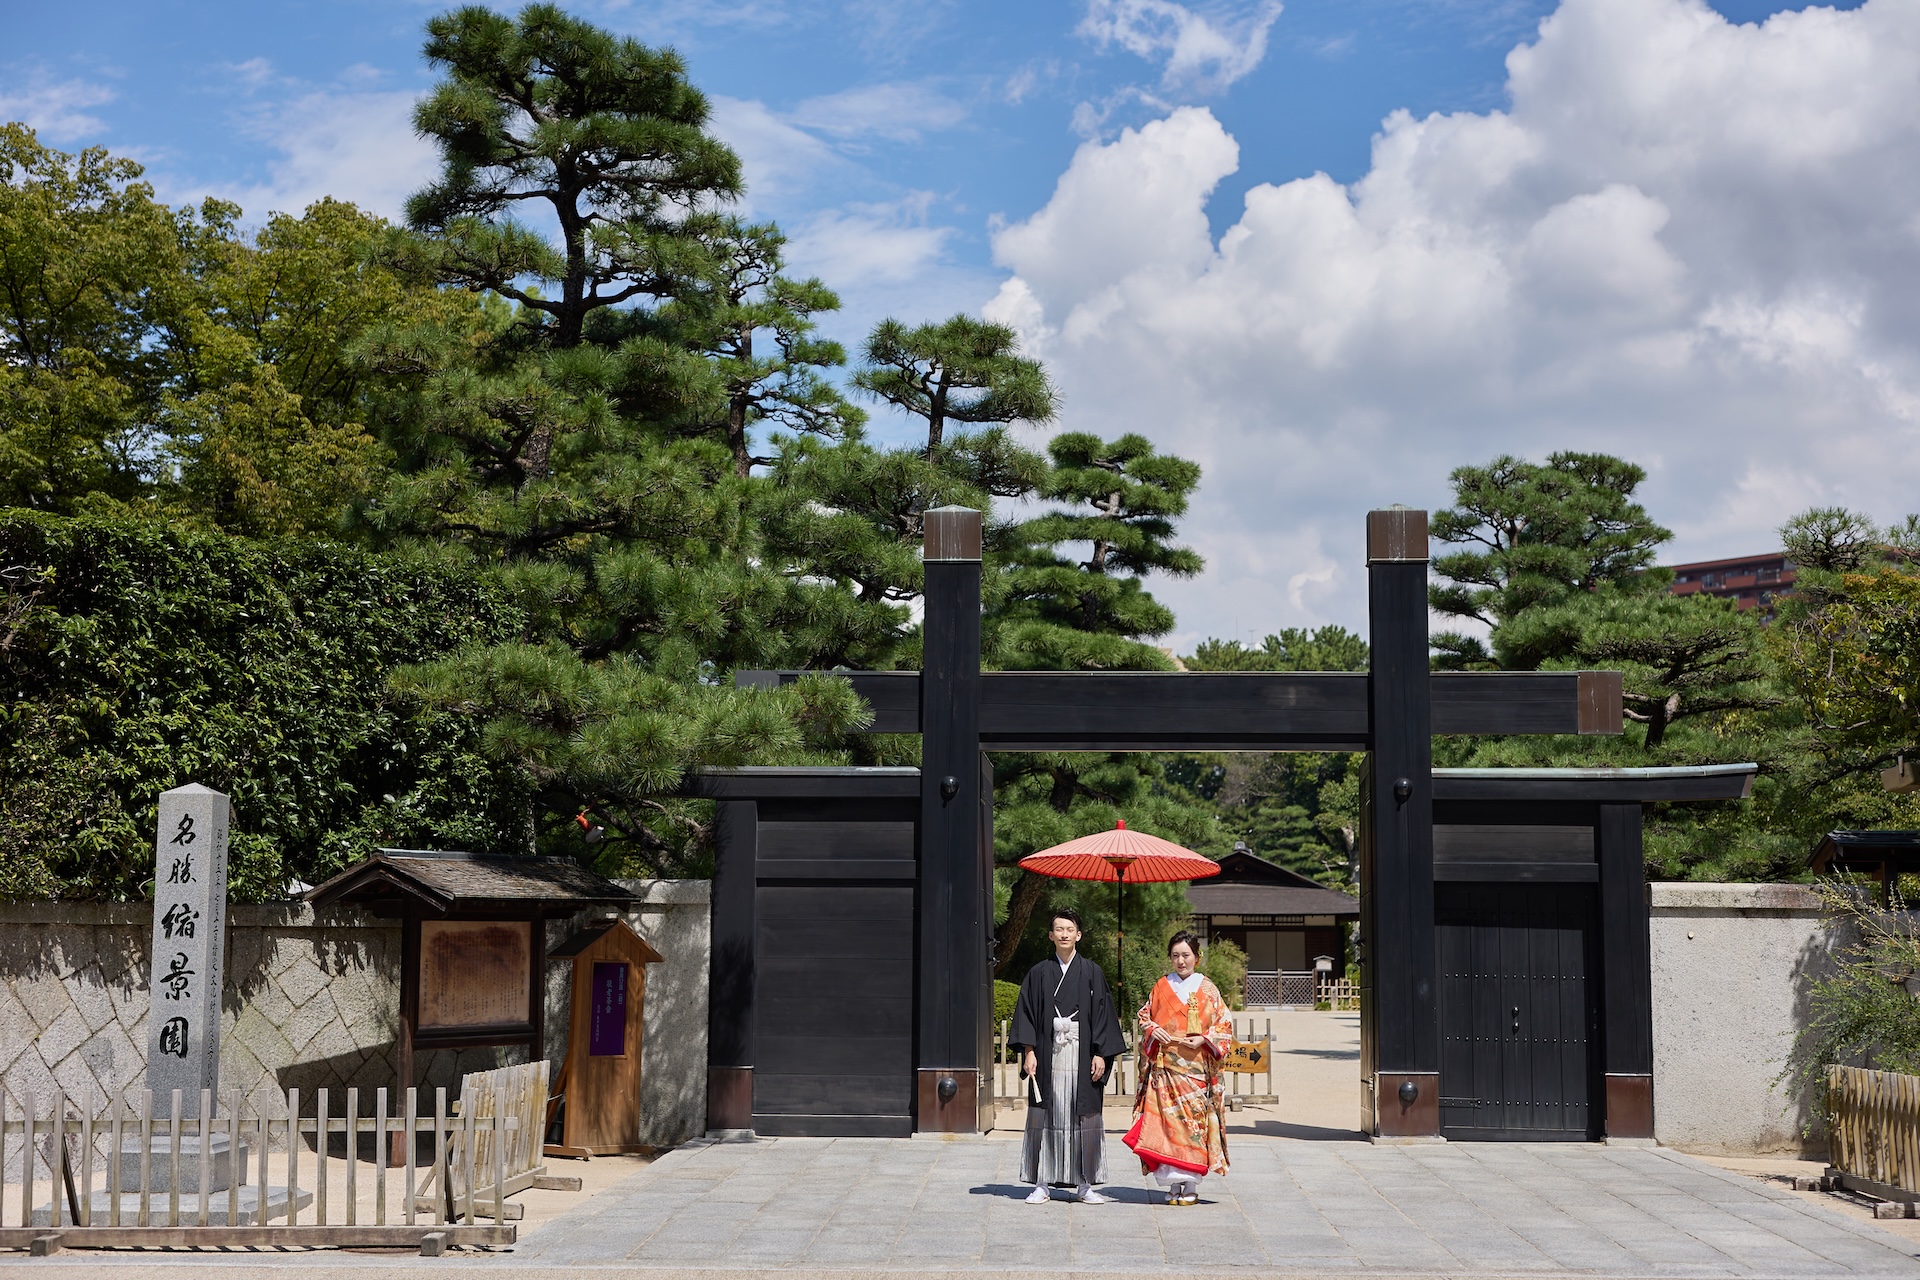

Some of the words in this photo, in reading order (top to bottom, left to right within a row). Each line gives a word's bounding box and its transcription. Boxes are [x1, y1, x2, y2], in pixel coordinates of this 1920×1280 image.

[160, 813, 200, 1059] 名勝縮景園
